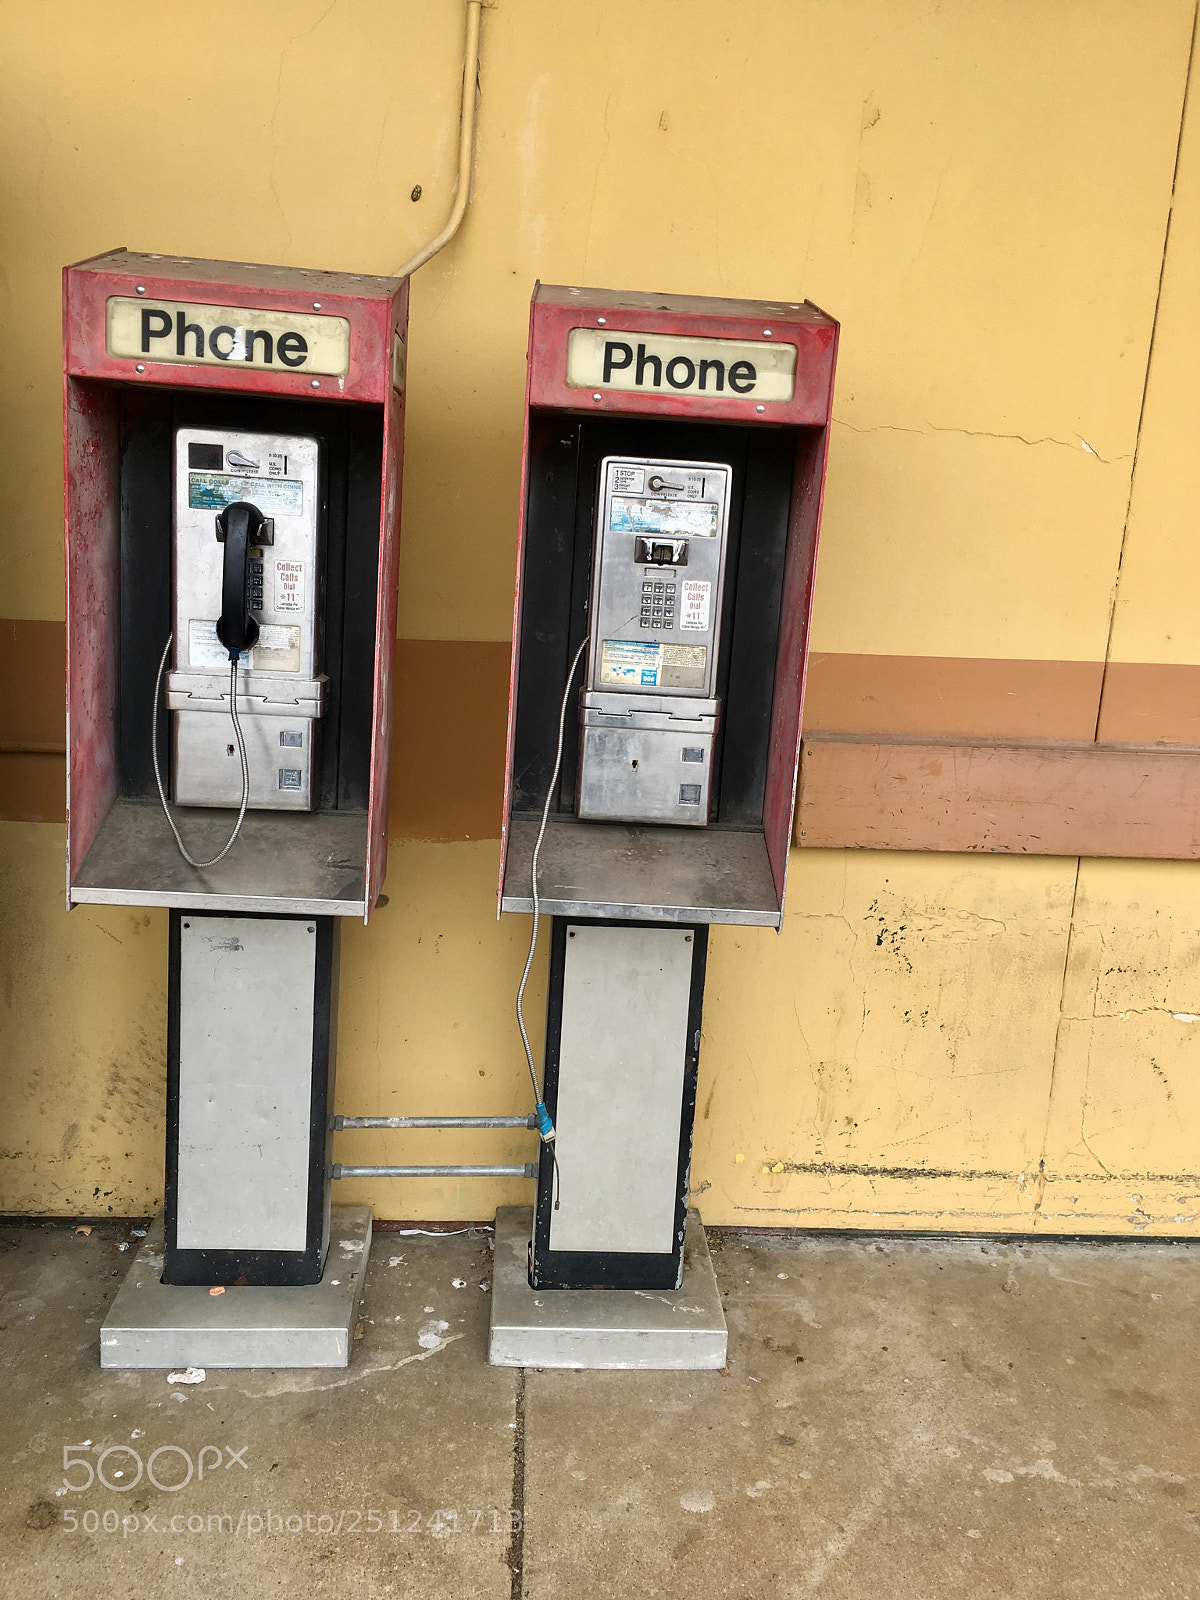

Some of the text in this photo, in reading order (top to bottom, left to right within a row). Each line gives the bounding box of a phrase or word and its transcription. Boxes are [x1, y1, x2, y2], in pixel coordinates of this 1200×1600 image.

[141, 308, 308, 367] Phone
[603, 341, 757, 394] Phone
[276, 562, 302, 572] Collect
[280, 572, 298, 582] Calls
[684, 582, 709, 592] Collect
[687, 593, 705, 601] Calls
[689, 602, 701, 610] Dial
